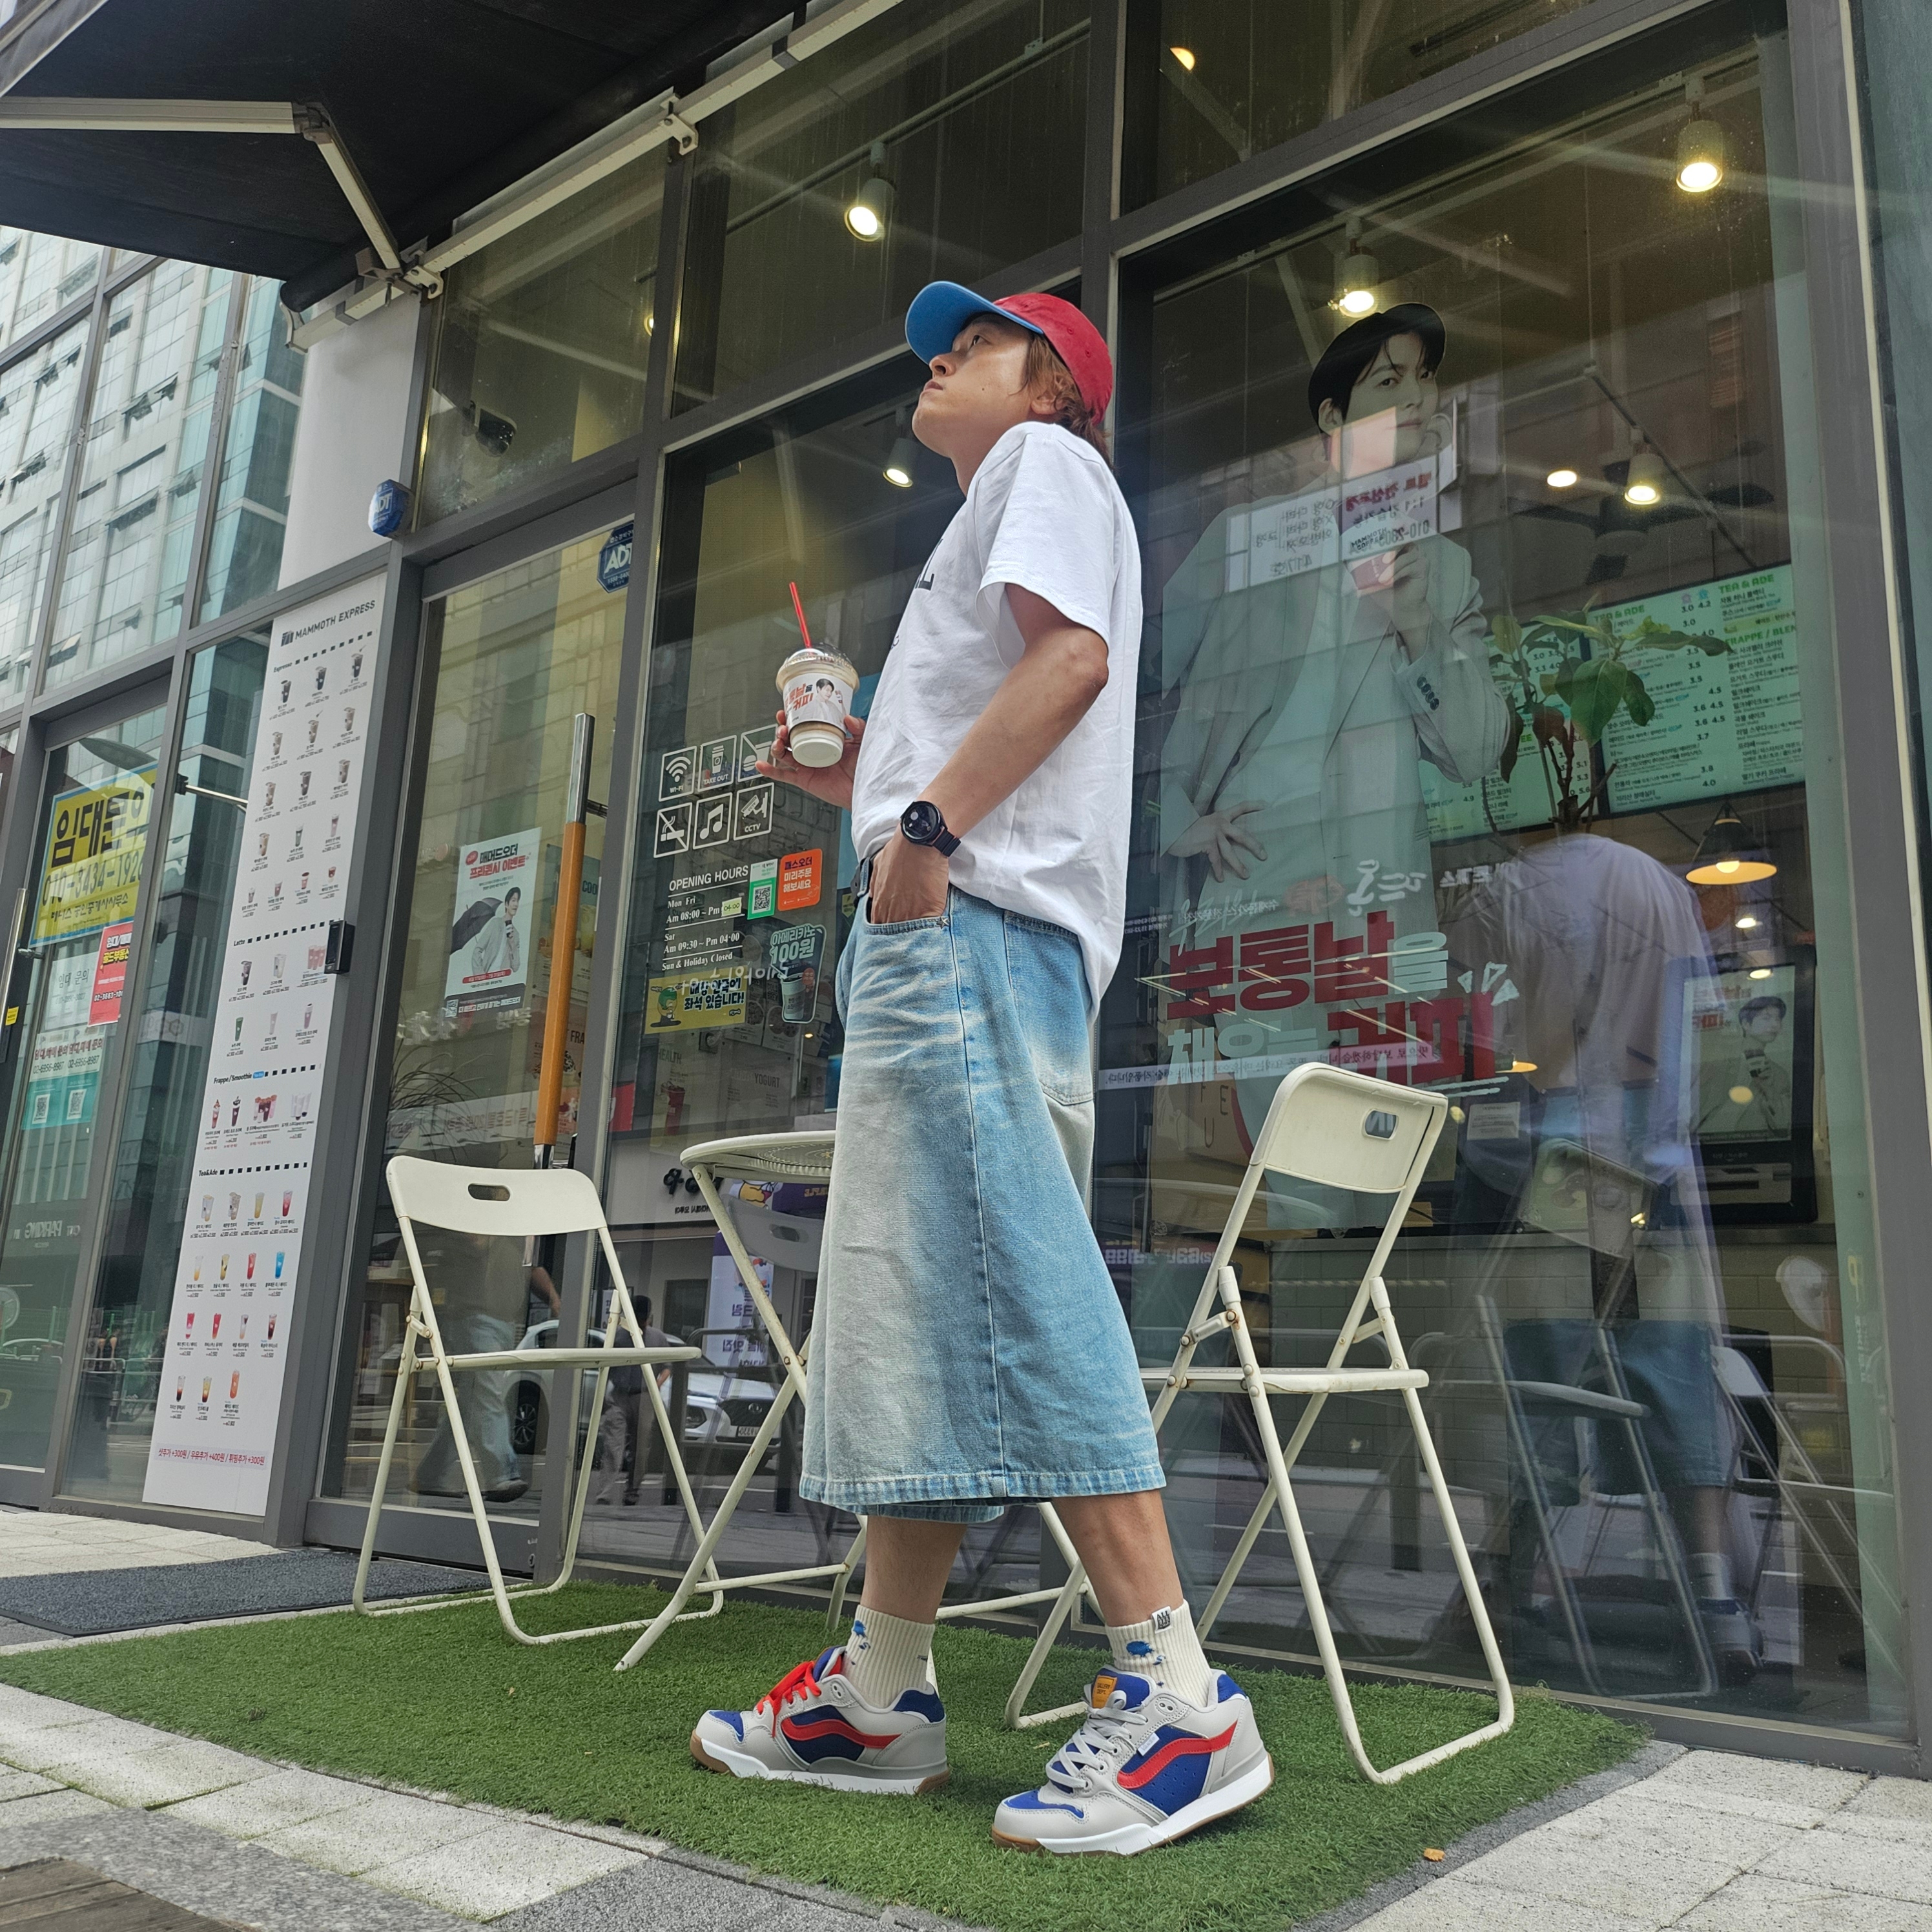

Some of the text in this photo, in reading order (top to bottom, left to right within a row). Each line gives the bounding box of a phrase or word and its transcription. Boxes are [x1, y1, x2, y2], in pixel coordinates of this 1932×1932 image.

[1718, 582, 1740, 593] TEA
[1752, 574, 1774, 586] ADE
[1623, 605, 1645, 616] ADE
[295, 600, 376, 640] MAMMOTH EXPRESS
[1683, 619, 1696, 627] 3.0
[273, 663, 293, 673] Espresso
[1688, 661, 1701, 670] 3.5
[1690, 675, 1703, 684] 3.5
[1709, 686, 1721, 695] 4.5
[717, 774, 729, 782] OUT
[670, 785, 684, 794] WI-FI
[744, 823, 761, 833] CCTV
[479, 843, 519, 865] 매머드오더
[502, 854, 526, 872] 이벤트
[785, 856, 812, 870] 패스오더
[669, 872, 712, 892] OPENING
[714, 865, 749, 883] HOURS
[784, 867, 812, 881] 미리주문
[783, 879, 812, 893] 해보세요
[668, 896, 696, 909] Mon Fri
[666, 906, 720, 924] Am 08:00 Pm
[772, 925, 816, 946] 아메리카노
[663, 945, 676, 954] Am
[678, 940, 698, 951] 09:30
[706, 937, 718, 947] Pm
[770, 936, 816, 965] 100원
[662, 963, 675, 971] Sun
[675, 960, 682, 969] &
[684, 956, 708, 966] Holiday
[1167, 910, 1449, 1020] 보통날을
[58, 972, 72, 989] 임대
[75, 969, 90, 985] 문의
[684, 991, 745, 1011] 좌석 있습니다!
[1328, 991, 1494, 1085] 커피
[213, 1073, 252, 1085] Frappe/Smoothie
[754, 1073, 781, 1089] YOGURT
